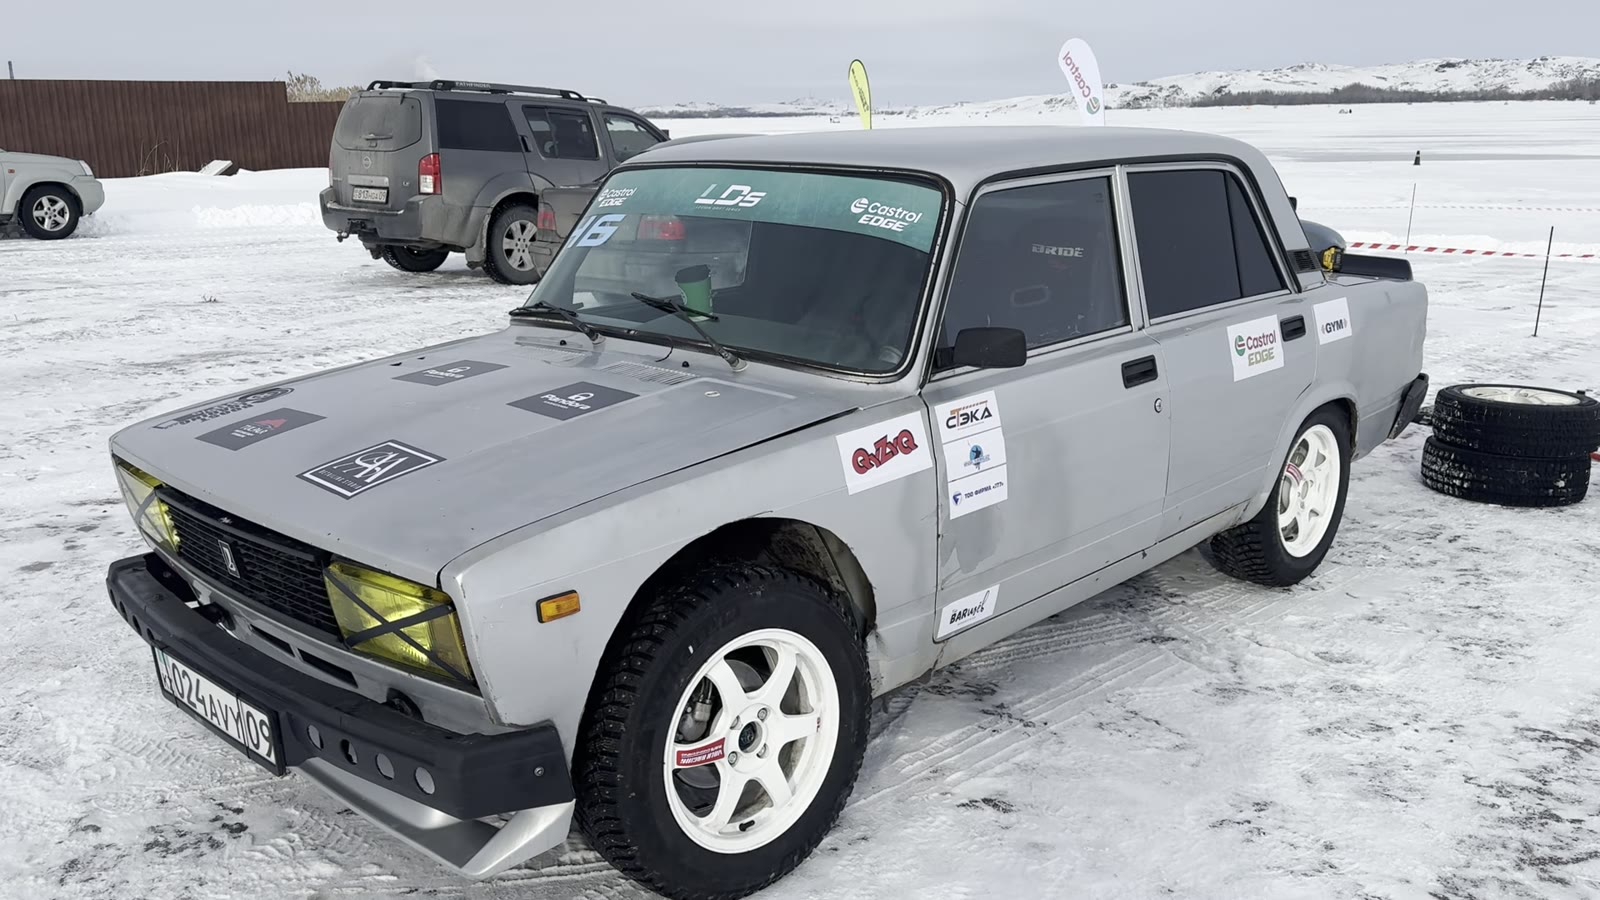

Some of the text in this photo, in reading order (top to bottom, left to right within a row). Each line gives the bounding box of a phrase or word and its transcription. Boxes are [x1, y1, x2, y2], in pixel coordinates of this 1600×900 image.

[607, 187, 638, 197] Castrol
[599, 198, 627, 208] EDGE
[867, 202, 923, 223] Castrol
[858, 214, 909, 232] EDGE
[1031, 243, 1085, 258] BRIDE
[1325, 319, 1344, 334] GYM
[1246, 330, 1277, 350] Castrol
[1248, 347, 1276, 366] EDGE
